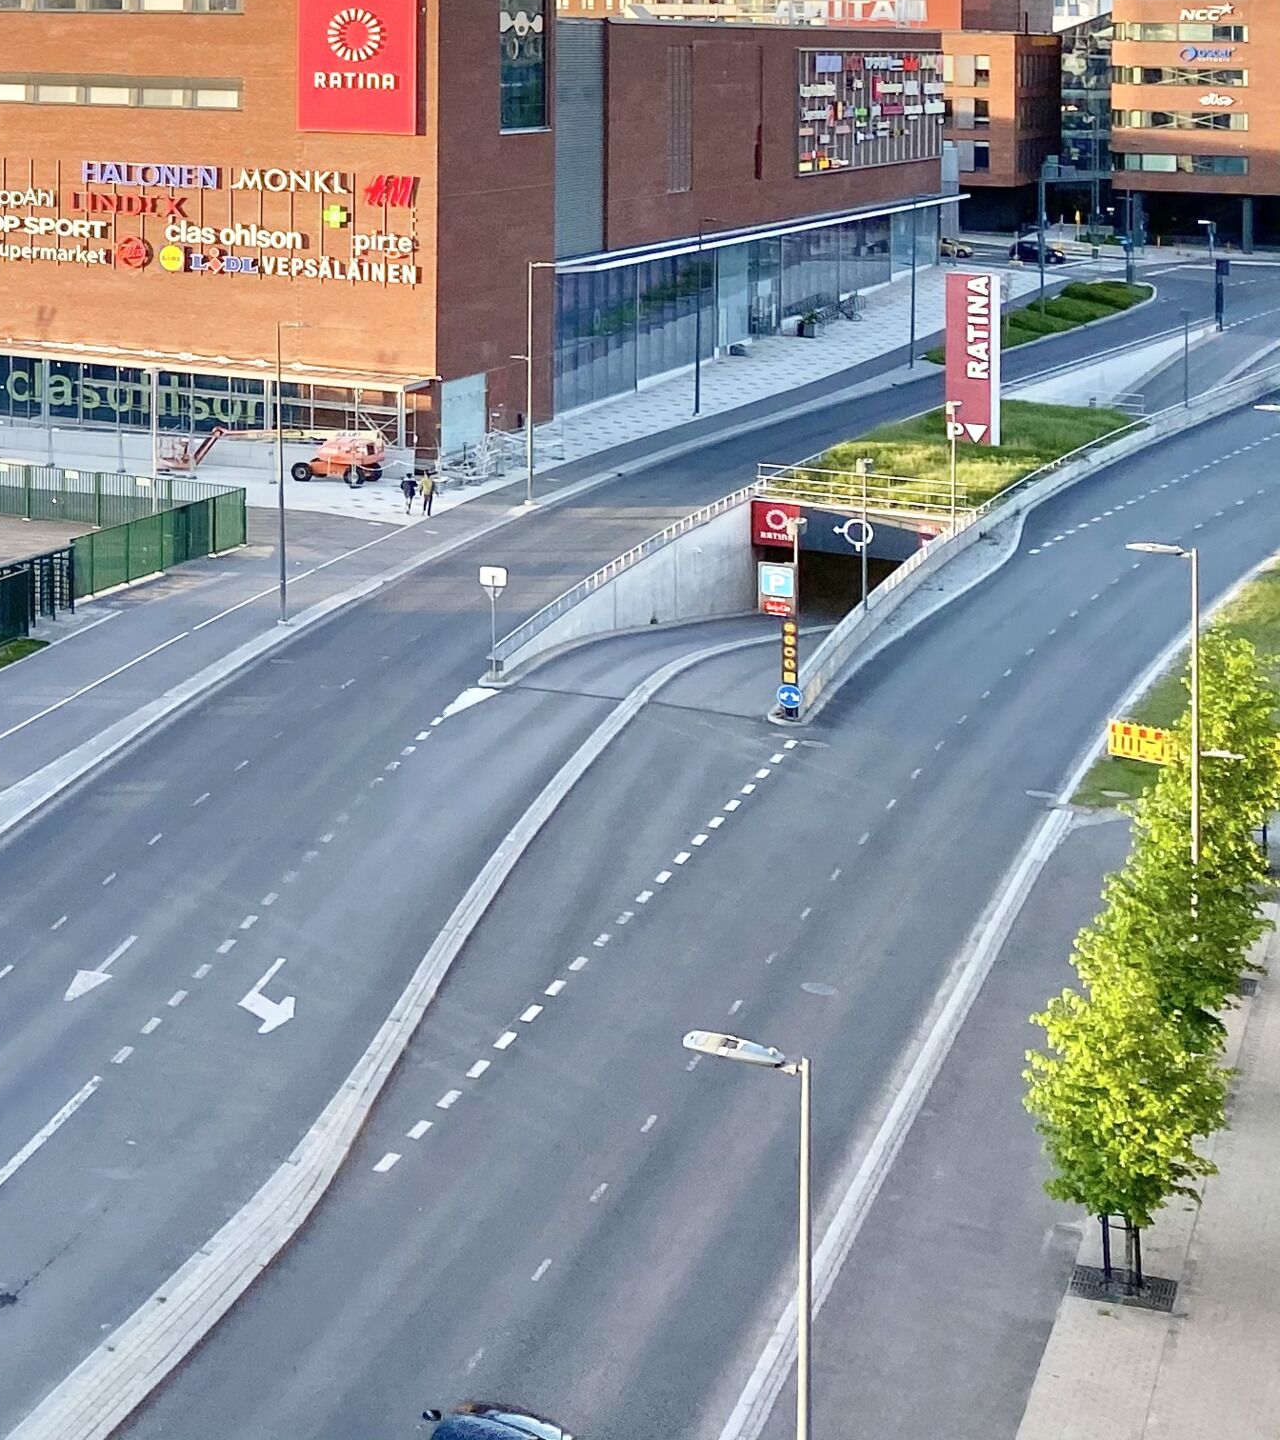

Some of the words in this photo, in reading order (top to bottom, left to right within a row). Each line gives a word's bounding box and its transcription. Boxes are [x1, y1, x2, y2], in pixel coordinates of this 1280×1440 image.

[1180, 9, 1221, 21] NCC
[314, 71, 395, 90] RATINA
[81, 160, 217, 189] HALONEN
[231, 168, 347, 194] MONKI
[363, 175, 414, 208] H&M
[69, 192, 189, 218] LINDEX
[24, 216, 107, 239] SPORT
[165, 220, 216, 244] clas
[220, 224, 302, 249] ohlson
[353, 229, 413, 256] pirte
[262, 256, 417, 284] VEPSÄLÄINEN
[967, 275, 989, 379] RATINA
[770, 574, 786, 593] P
